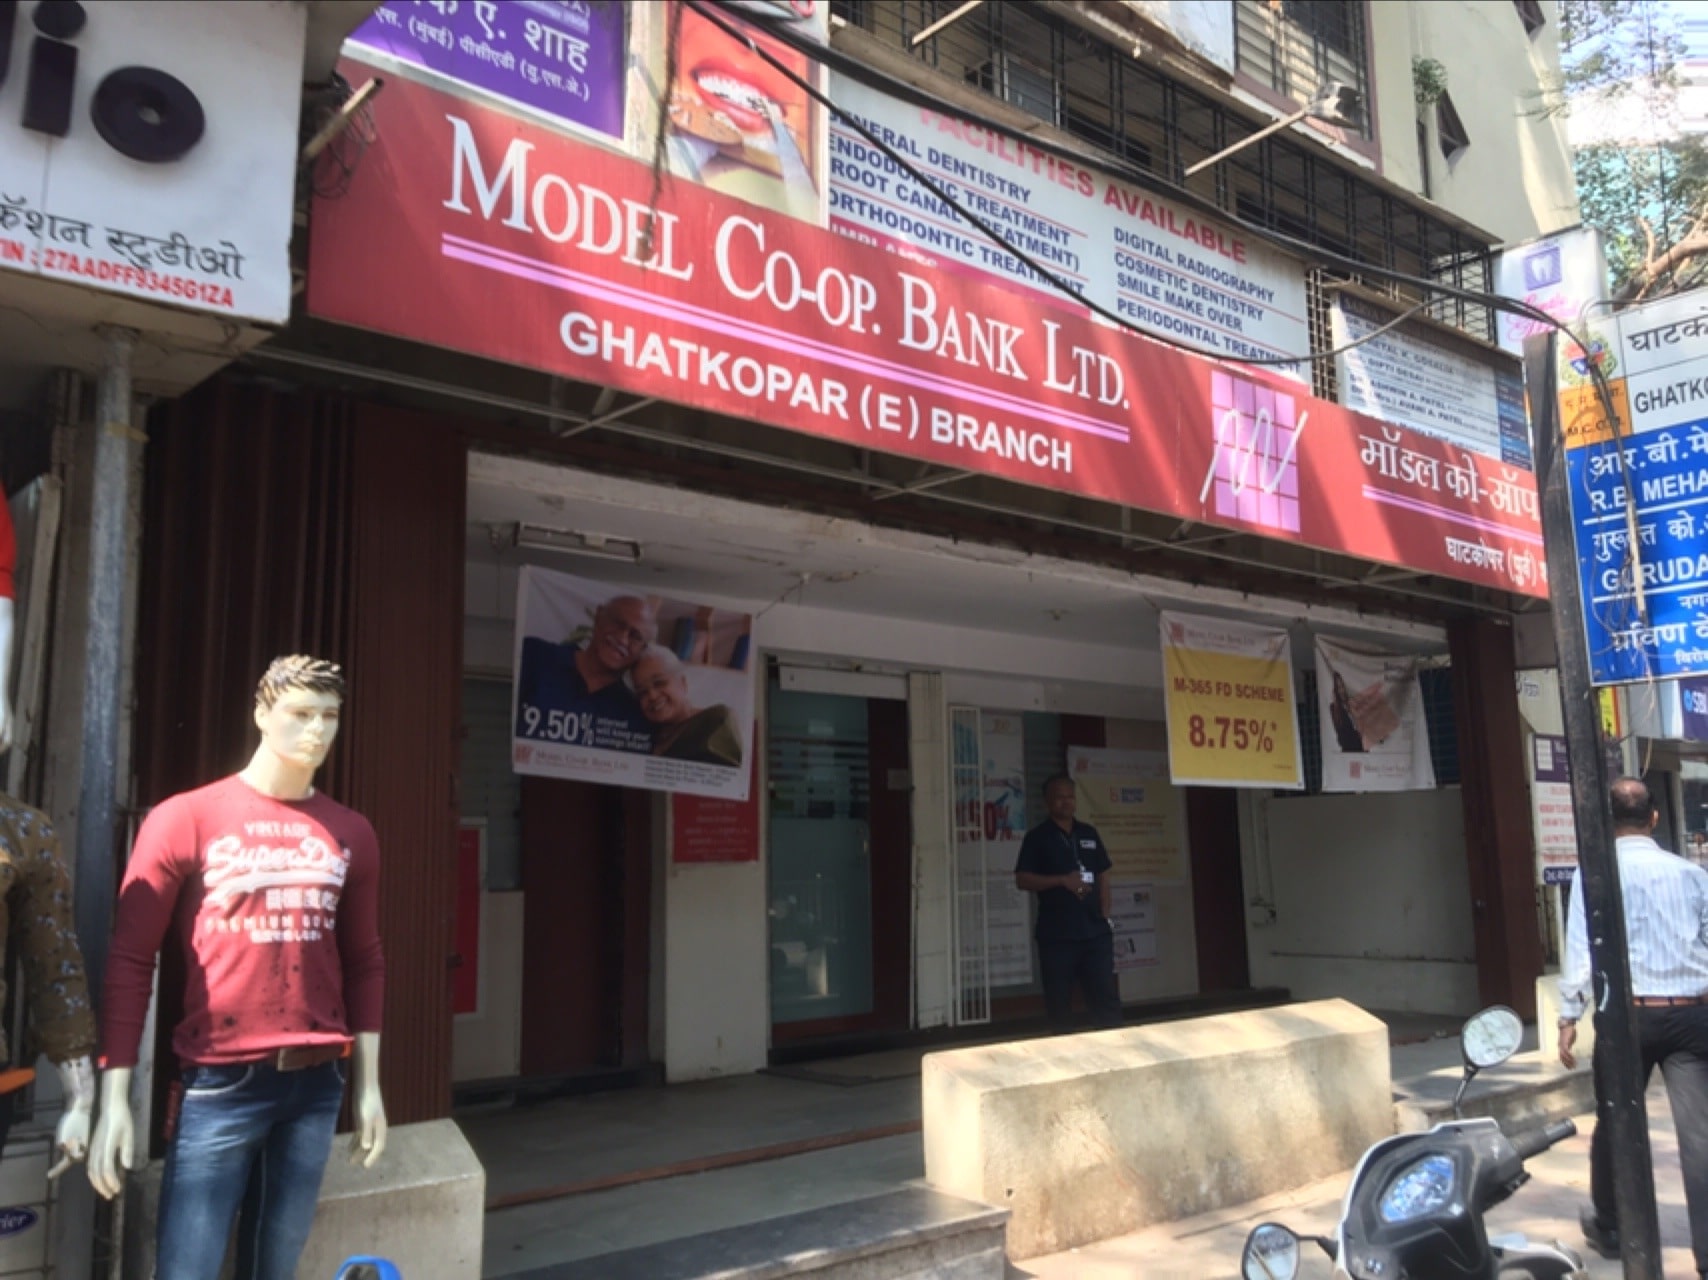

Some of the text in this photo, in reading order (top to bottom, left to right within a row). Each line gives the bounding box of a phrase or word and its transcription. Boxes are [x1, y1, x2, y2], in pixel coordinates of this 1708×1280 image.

[523, 19, 591, 73] शाह
[829, 133, 1071, 246] ENDODOTIC TREATMENT
[895, 180, 963, 223] CANAL
[927, 146, 1032, 203] DENTISTRY
[104, 227, 247, 280] स्टुडीओ
[1103, 183, 1247, 265] AVAILABLE
[1113, 226, 1275, 304] DIGITAL RADIOGRAPHY
[1113, 251, 1264, 322] COSMETIC DENTISTRY
[898, 271, 1029, 381] BANK
[1117, 272, 1243, 332] SMILE MAKE OVER
[1117, 297, 1220, 348] PERIODONTAL
[559, 311, 849, 420] GHATKOPAR
[931, 407, 1073, 473] BRANCH
[1359, 426, 1441, 492] मॉडल
[1444, 535, 1505, 574] घाटकोपर
[1173, 677, 1285, 703] M-365 FD SCHEME
